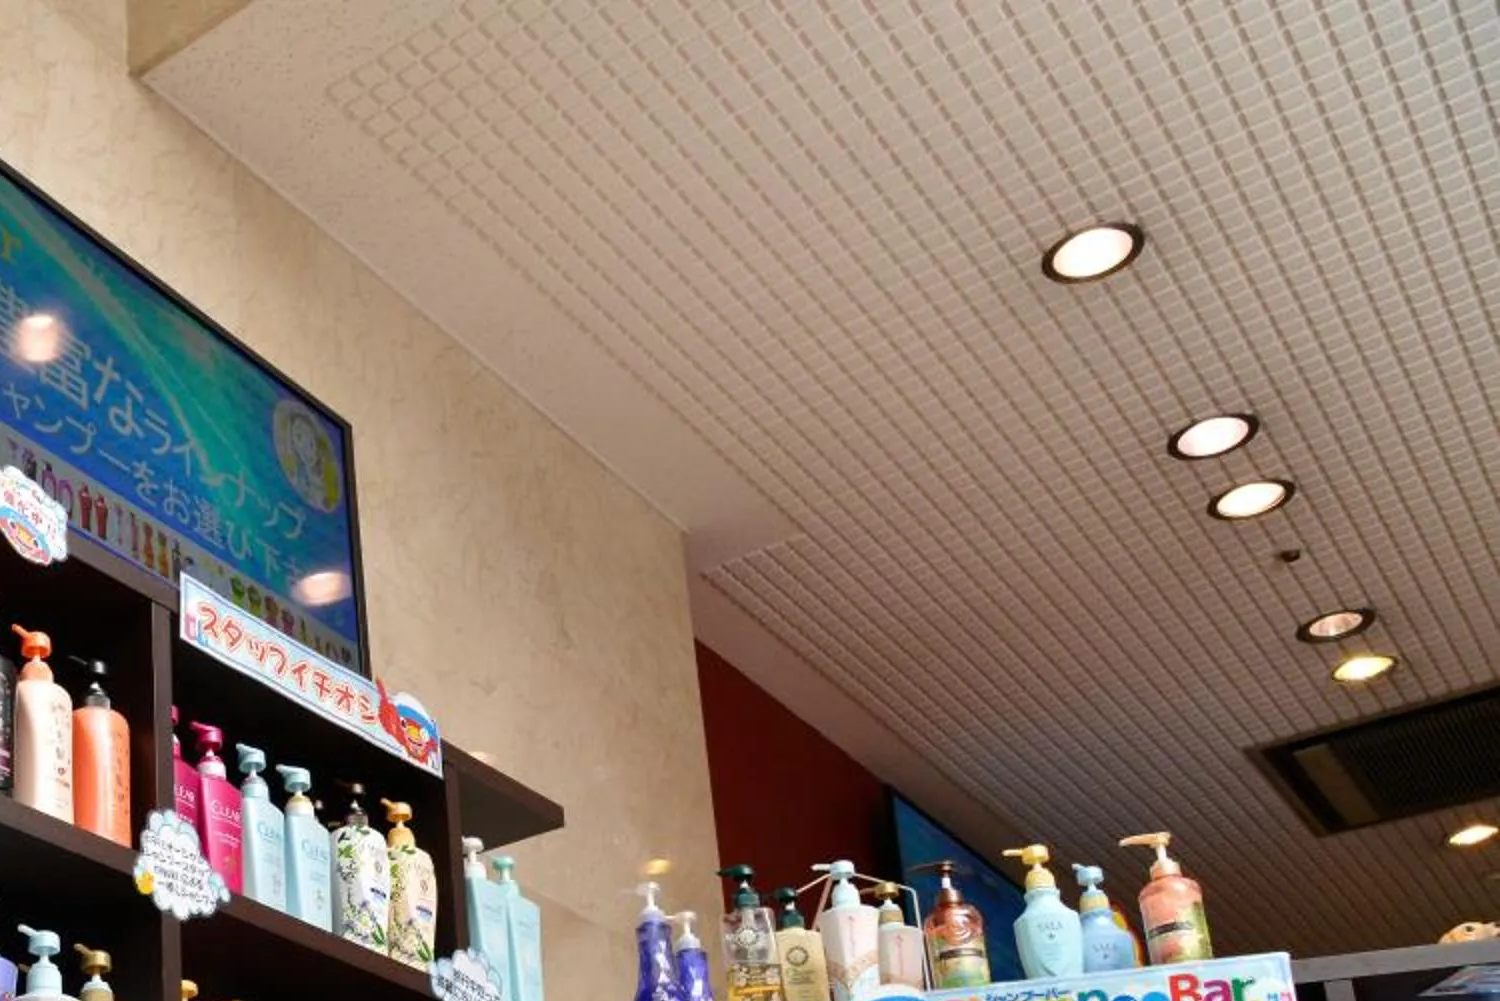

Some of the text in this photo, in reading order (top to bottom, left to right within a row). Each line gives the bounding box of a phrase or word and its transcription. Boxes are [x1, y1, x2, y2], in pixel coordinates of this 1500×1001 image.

[199, 605, 378, 722] スタッフイチオシ
